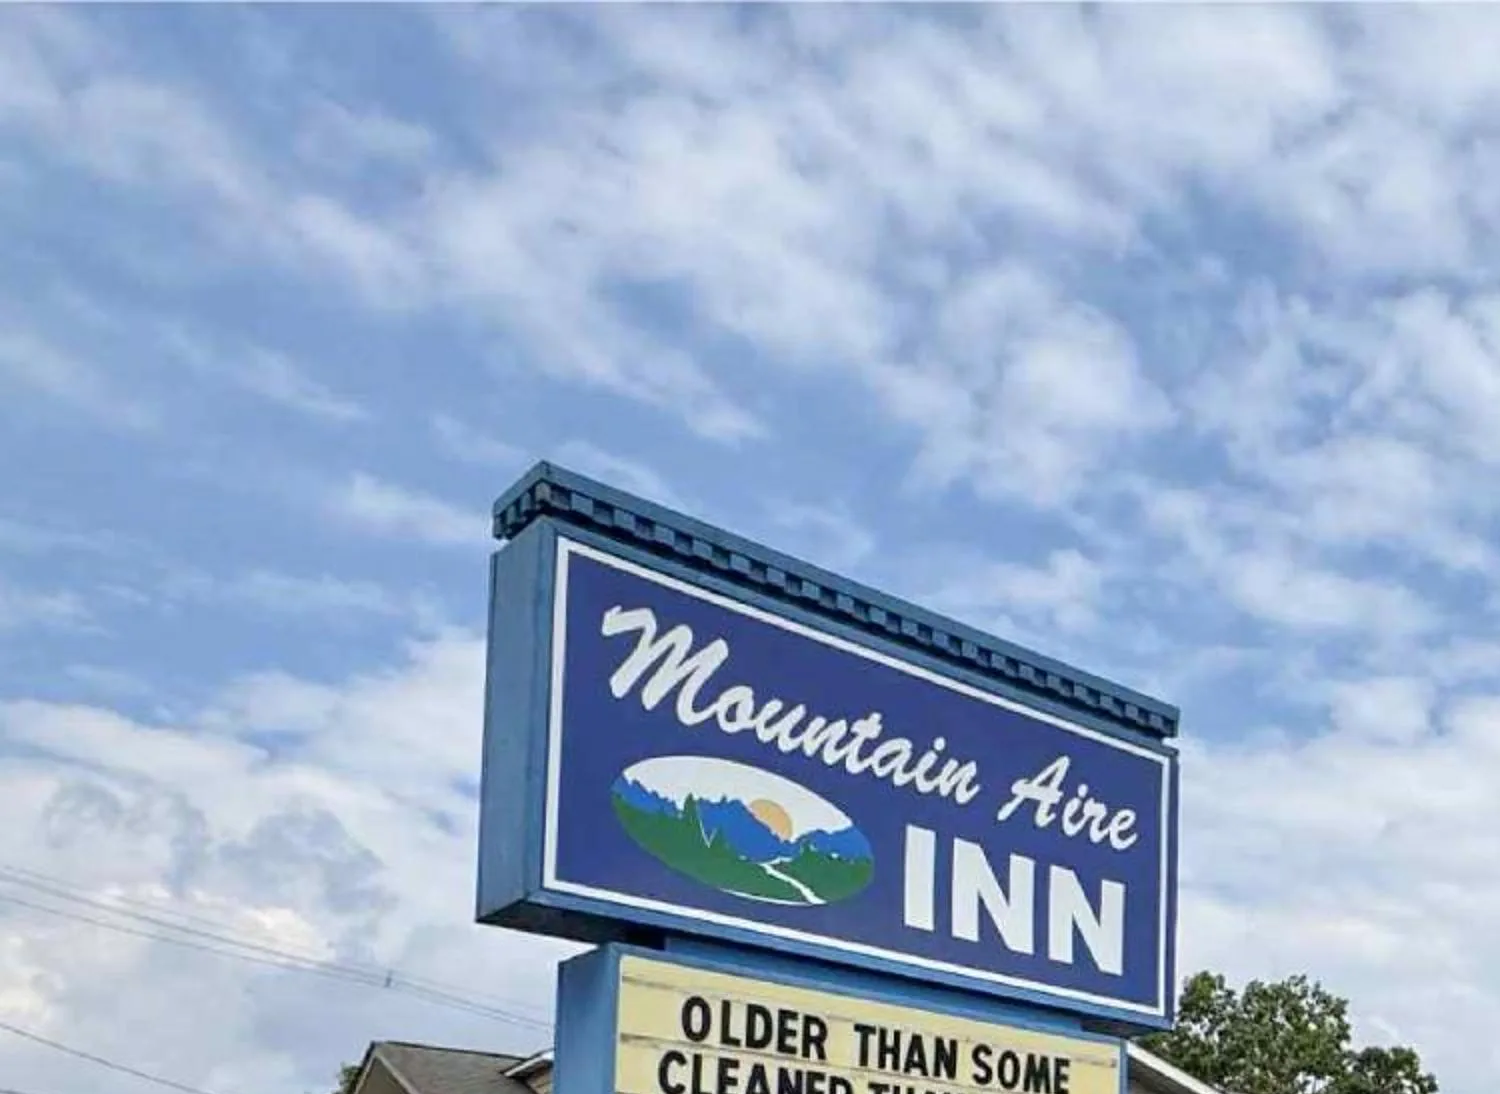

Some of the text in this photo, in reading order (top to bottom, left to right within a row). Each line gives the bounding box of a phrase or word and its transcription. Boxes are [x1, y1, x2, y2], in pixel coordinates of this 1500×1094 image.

[602, 606, 1138, 850] Mountain Aire
[904, 824, 1126, 976] INN
[681, 996, 828, 1060] OLDER
[854, 1024, 957, 1079] THAN
